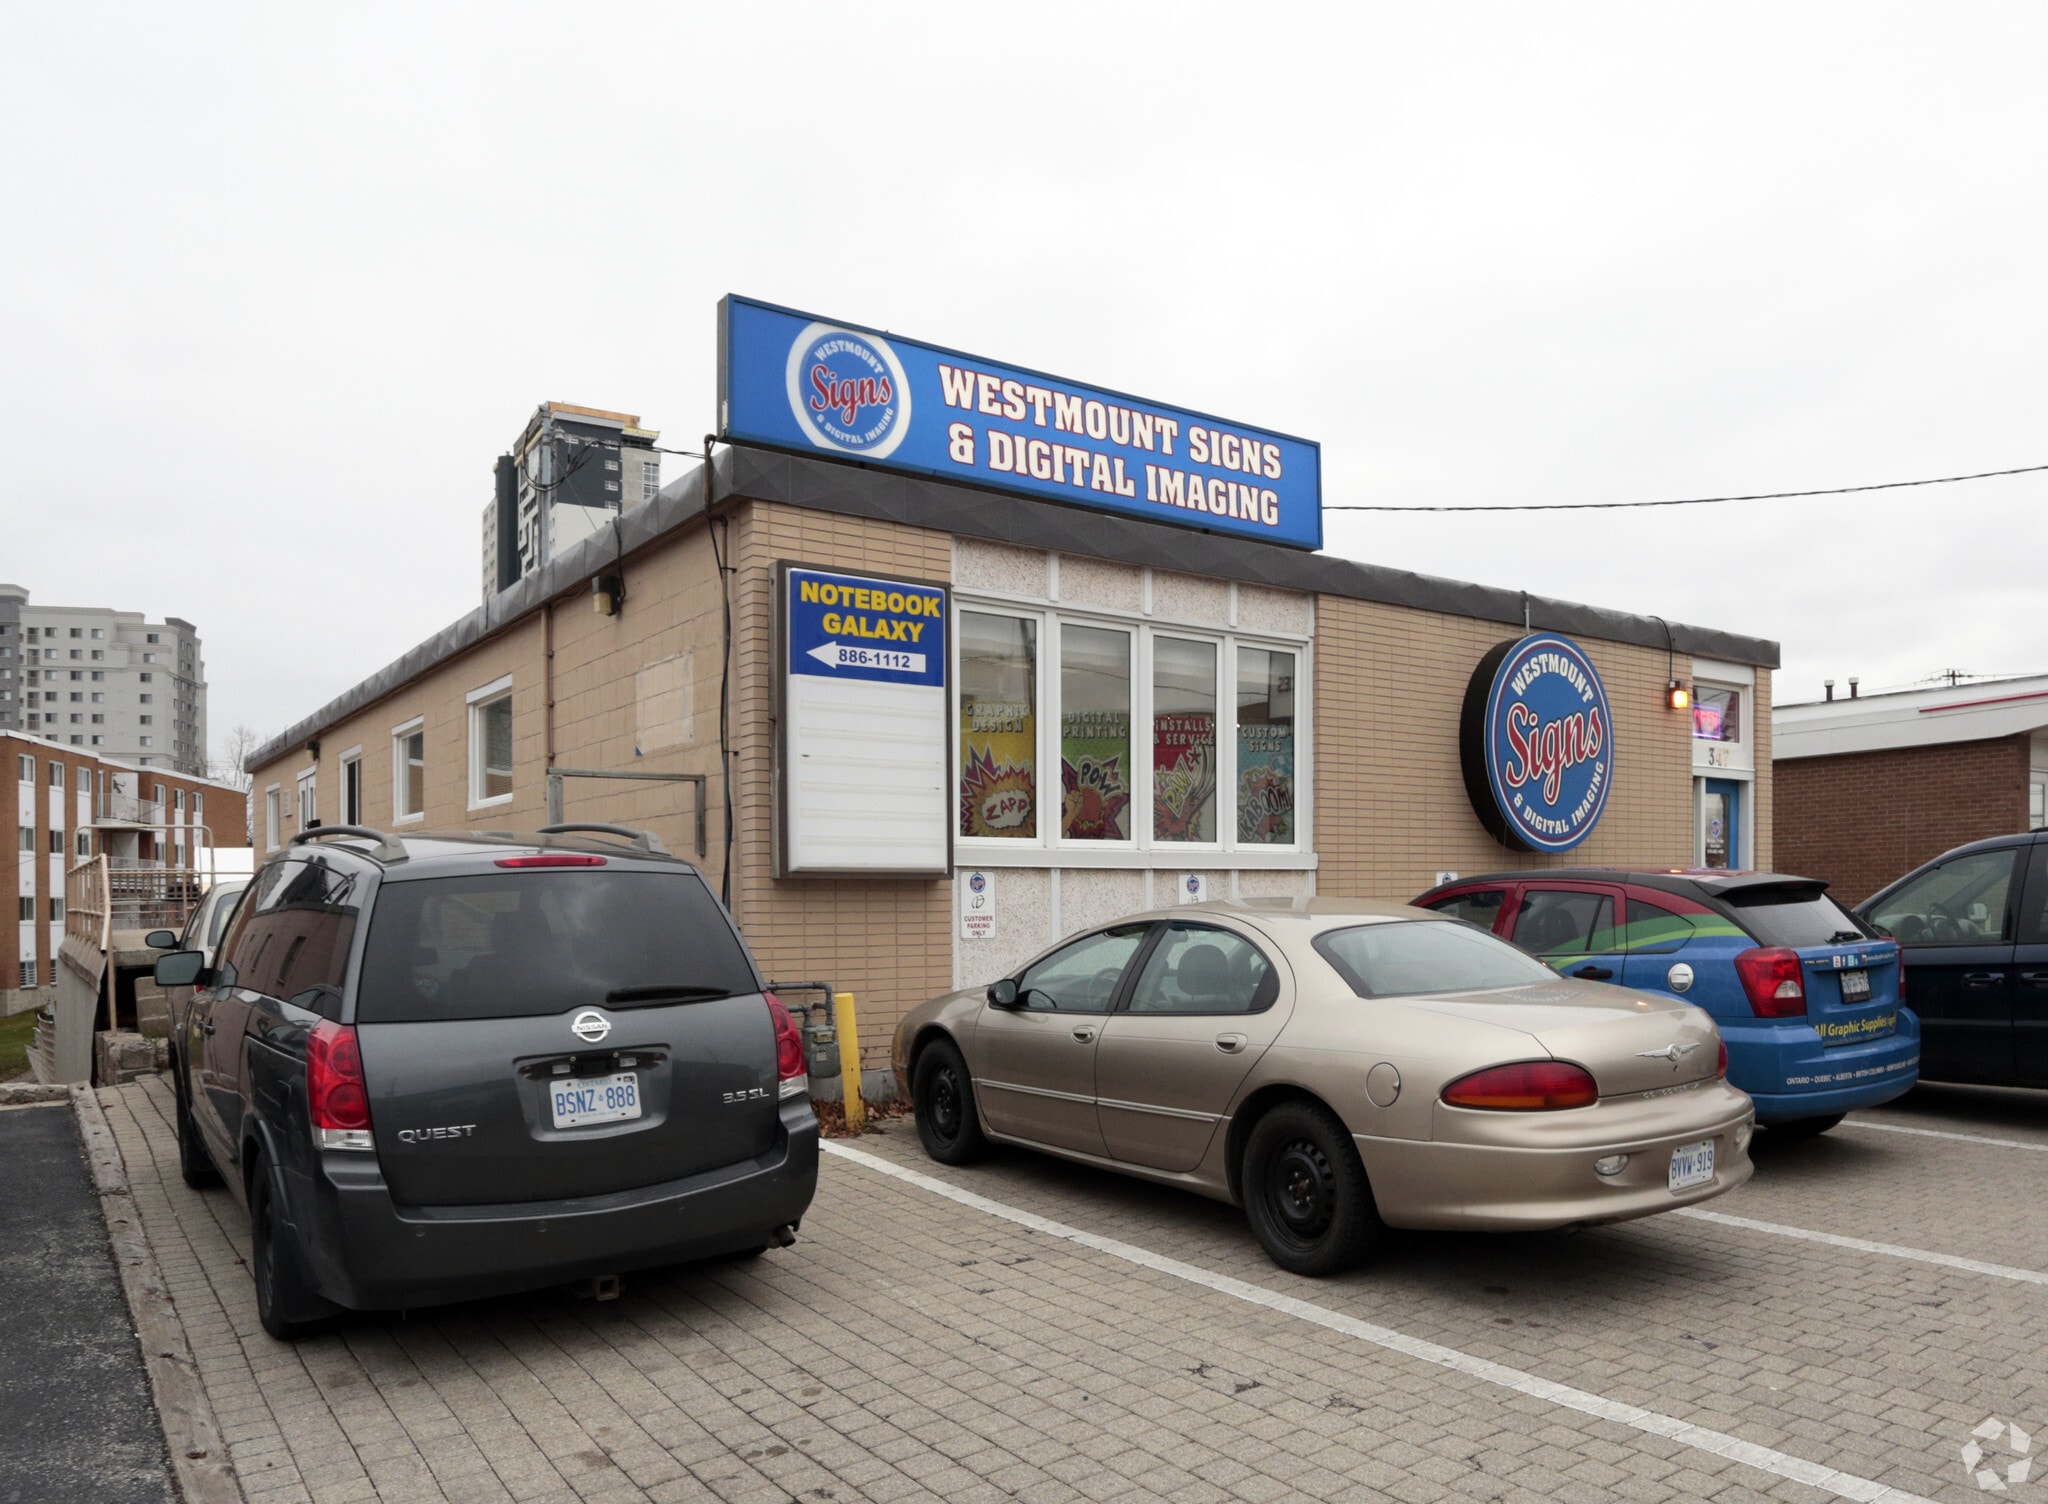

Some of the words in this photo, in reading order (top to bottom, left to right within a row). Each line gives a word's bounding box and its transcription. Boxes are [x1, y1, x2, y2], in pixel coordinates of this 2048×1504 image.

[814, 340, 884, 374] WESTMOUNT
[810, 364, 892, 427] Signs
[824, 422, 864, 444] DIGITAL
[865, 407, 894, 442] IMAGING
[938, 364, 1179, 455] WESTMOUNT
[1188, 425, 1282, 480] SIGNS
[948, 422, 975, 465] &
[987, 429, 1136, 498] DIGITAL
[1145, 464, 1279, 526] IMAGING
[800, 580, 942, 618] NOTEBOOK
[822, 612, 925, 643] GALAXY
[838, 648, 911, 669] 886-1112
[1510, 653, 1595, 703] WESTMOUNT
[1241, 727, 1287, 739] CUSTOM
[1505, 702, 1603, 806] Signs
[1080, 761, 1122, 798] POW
[986, 797, 1028, 820] ZAPP
[1514, 793, 1524, 808] &
[1523, 805, 1570, 835] DIGITAL
[1571, 761, 1604, 827] IMAGING
[576, 1022, 608, 1032] NISSAN
[1828, 1021, 1860, 1038] Graphic
[1861, 1015, 1887, 1032] Supplies
[1786, 1076, 1810, 1085] ONTARIO
[1814, 1074, 1832, 1084] QUEBEC
[555, 1089, 597, 1116] BSNZ
[606, 1085, 636, 1109] 888
[398, 1124, 476, 1143] QUEST
[1697, 1150, 1713, 1172] 919
